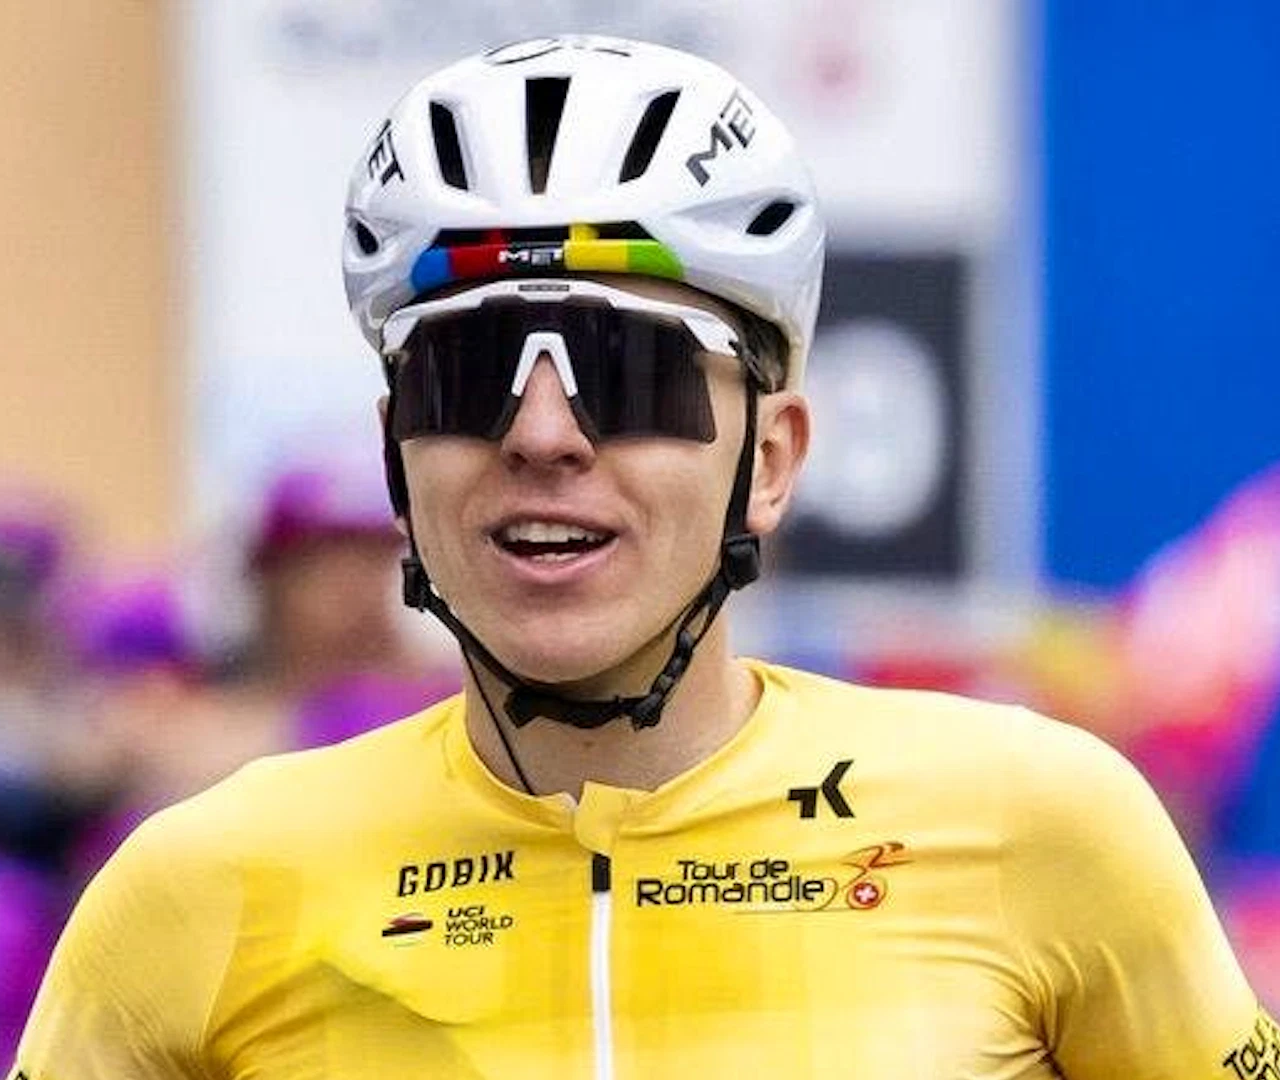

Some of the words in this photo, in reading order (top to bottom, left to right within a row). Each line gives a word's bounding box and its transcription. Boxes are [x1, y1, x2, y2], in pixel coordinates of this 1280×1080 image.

[498, 247, 564, 267] MET
[677, 860, 740, 881] Tour
[750, 858, 789, 879] de
[636, 875, 825, 907] Romandie
[448, 905, 485, 918] UCI
[445, 916, 514, 932] WORLD
[444, 932, 494, 945] TOUR
